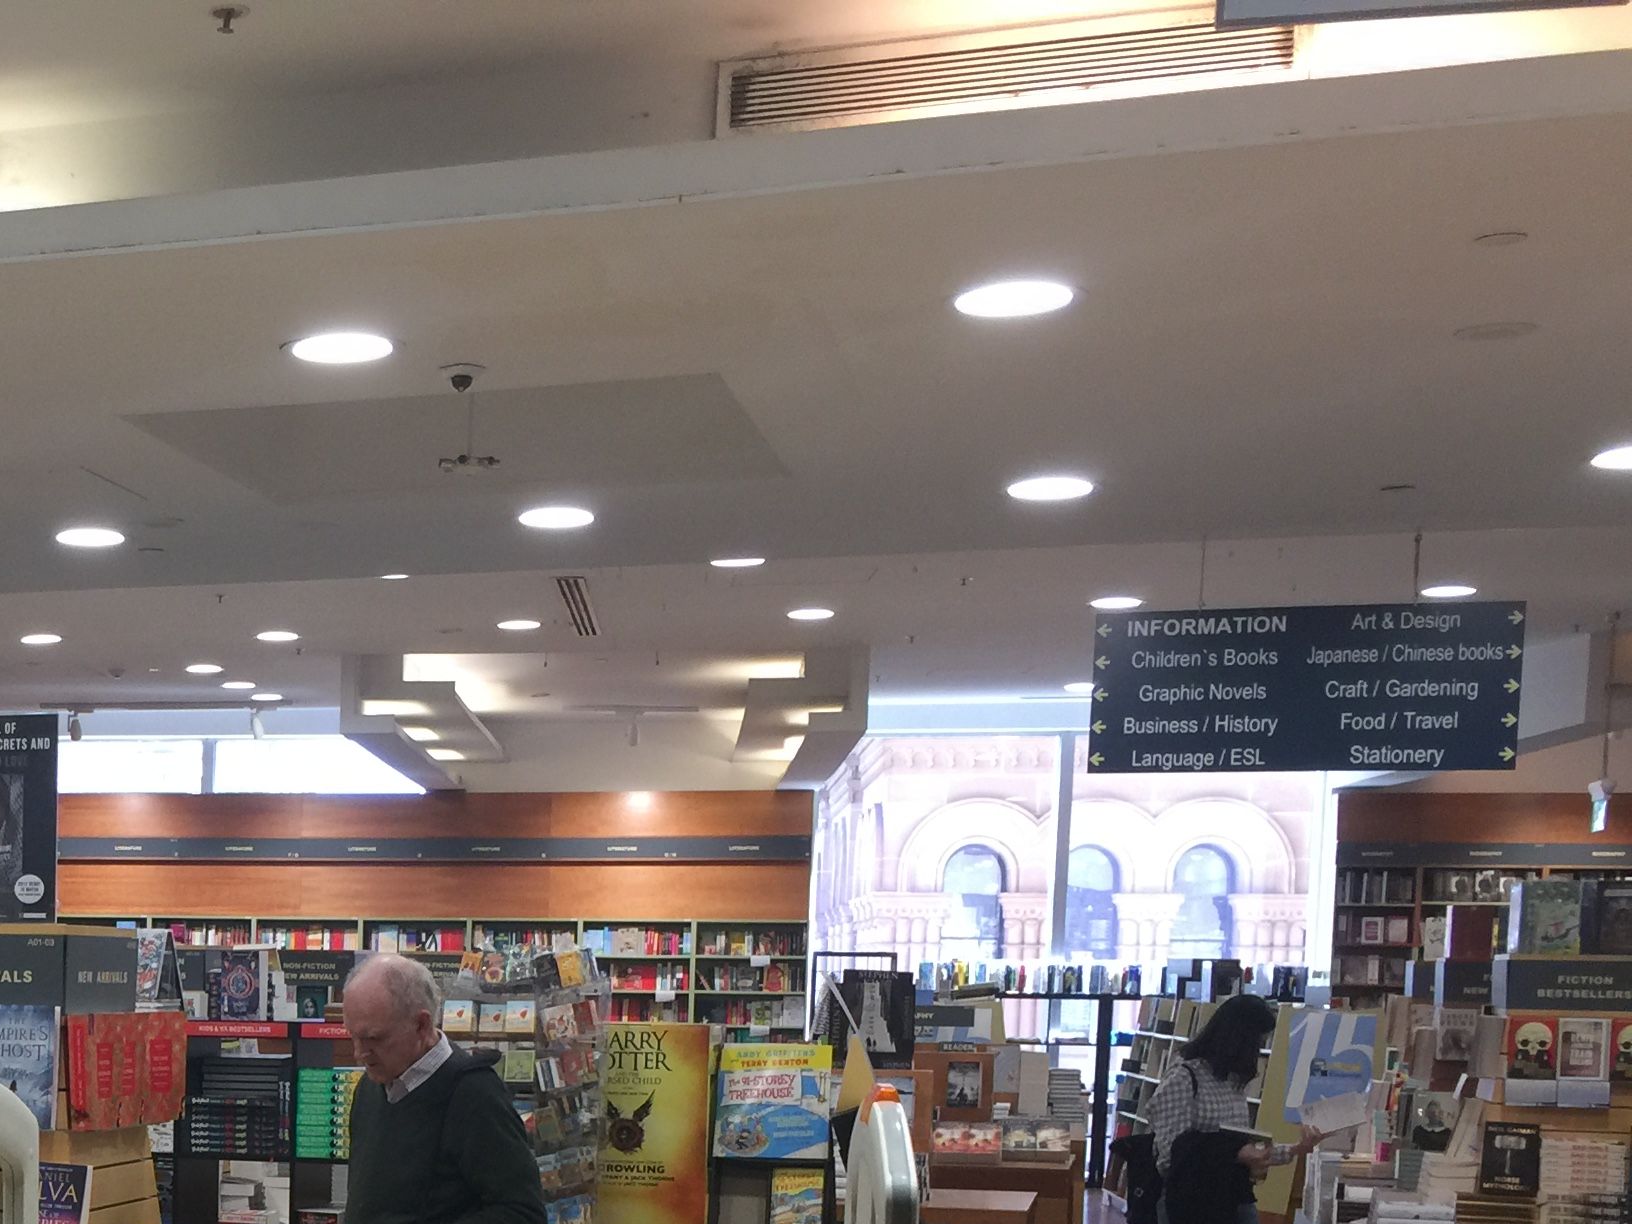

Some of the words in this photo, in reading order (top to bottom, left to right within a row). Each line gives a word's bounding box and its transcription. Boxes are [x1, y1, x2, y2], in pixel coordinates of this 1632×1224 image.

[1128, 616, 1287, 637] INFORMATION
[1352, 613, 1376, 629] Art
[1382, 613, 1394, 629] &
[1400, 612, 1461, 633] Design
[1224, 649, 1278, 665] Books
[1307, 646, 1378, 667] Japanese
[1383, 646, 1389, 663] /
[1392, 645, 1454, 663] Chinese
[1459, 644, 1504, 660] books
[1140, 684, 1204, 705] Graphic
[1209, 683, 1267, 700] Novels
[1325, 680, 1368, 699] Craft
[1374, 681, 1379, 697] /
[1386, 679, 1479, 701] Gardening
[5, 722, 16, 734] OF
[1124, 717, 1198, 734] Business
[1203, 717, 1209, 733] /
[1215, 715, 1278, 736] History
[1340, 713, 1385, 730] Food
[1391, 714, 1397, 729] /
[1404, 711, 1458, 729] Travel
[31, 737, 50, 749] AND
[1131, 749, 1215, 771] Language
[1219, 749, 1225, 765] /
[1230, 748, 1265, 765] ESL
[1349, 745, 1444, 766] Stationery
[78, 971, 93, 983] NEW
[97, 971, 128, 984] ARRIVALS
[1558, 975, 1613, 984] FICTION
[1537, 989, 1632, 999] BESTSELLERS
[608, 1052, 672, 1071] OTTER
[607, 1076, 629, 1085] RSED
[632, 1077, 661, 1085] CHILD
[729, 1087, 794, 1100] TREEHOUSE
[39, 1172, 70, 1183] ANIEL
[606, 1164, 664, 1173] ROWLING
[39, 1182, 77, 1203] LVA
